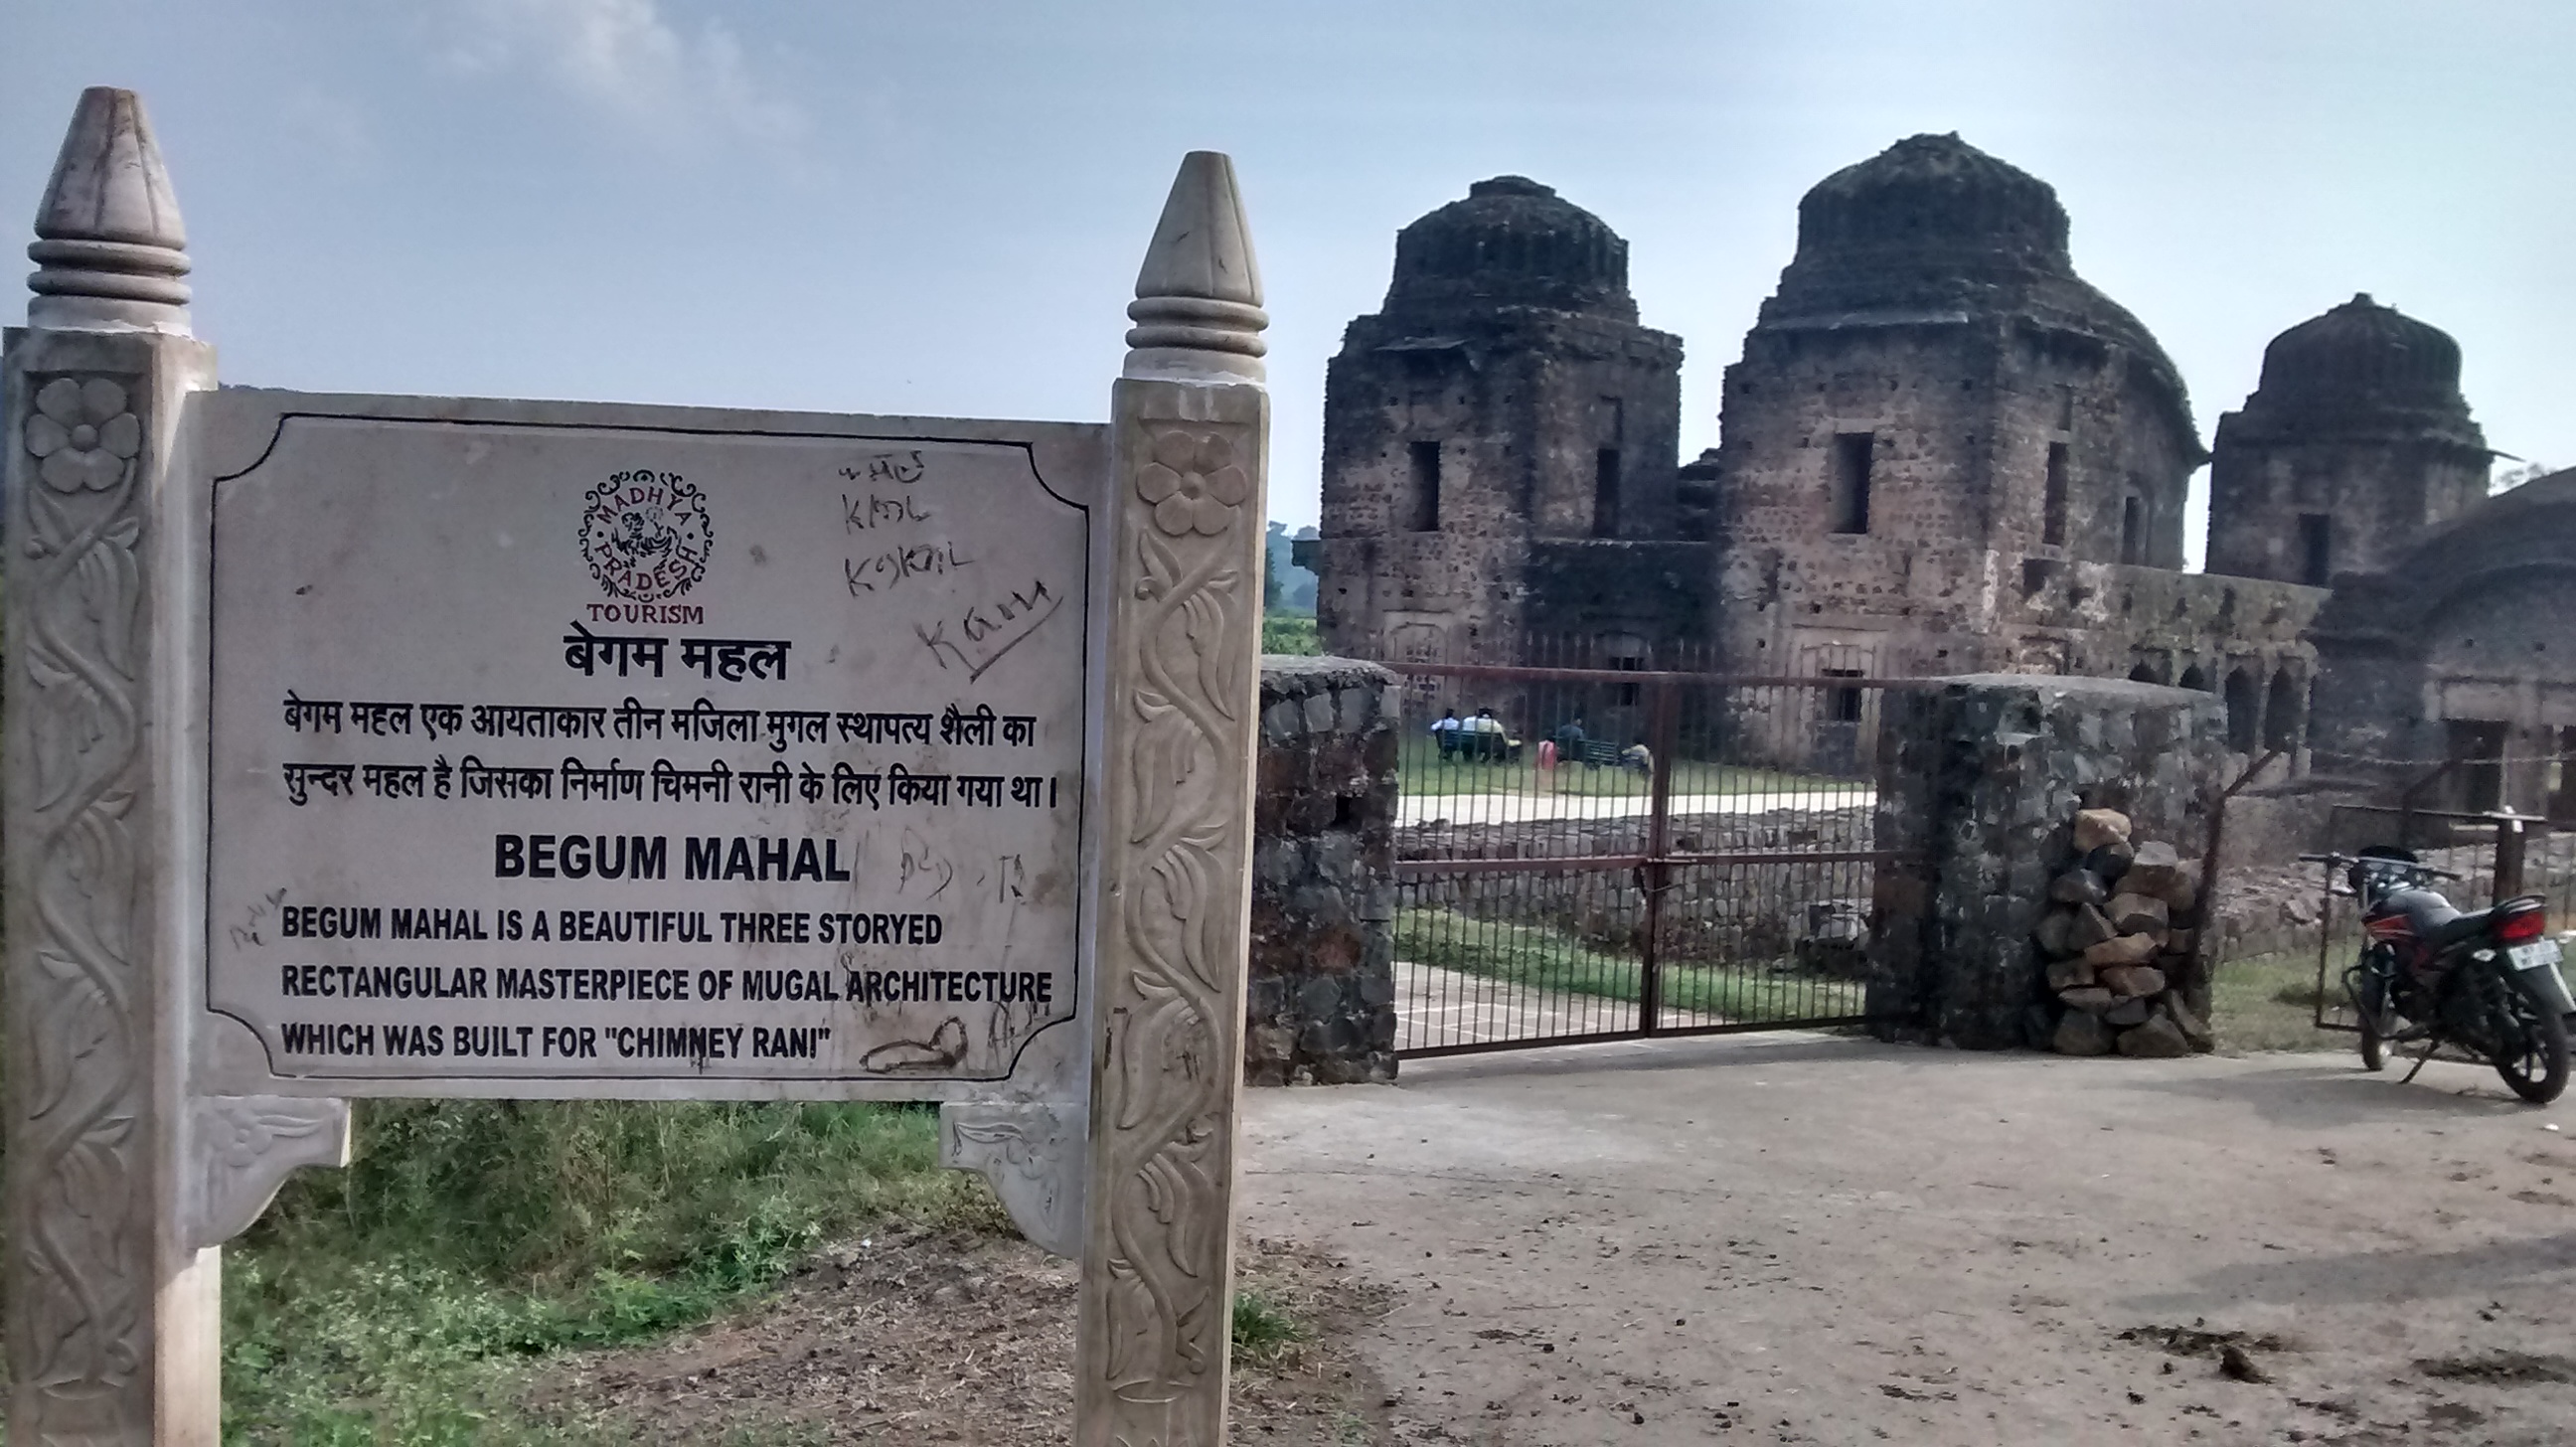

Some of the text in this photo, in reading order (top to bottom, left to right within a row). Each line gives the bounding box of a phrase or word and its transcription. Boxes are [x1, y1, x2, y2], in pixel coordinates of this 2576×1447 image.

[596, 486, 693, 525] MADHYA
[594, 541, 699, 591] PRADESH
[585, 603, 705, 625] TOURISM
[563, 619, 792, 683] बेगम महल
[283, 690, 1037, 752] बेगम महल एक आयताकार तीन मजिला मुगल स्थापत्य शैली का
[282, 762, 355, 807] सुन्दर
[362, 764, 427, 799] महल
[432, 754, 453, 800] है
[460, 754, 554, 800] जिसका
[560, 756, 645, 802] निर्माण
[651, 758, 733, 803] चिमनी
[738, 760, 793, 804] रानी
[798, 762, 826, 805] के
[831, 762, 882, 811] लिए
[887, 763, 952, 807] किया
[957, 775, 1005, 808] गया
[495, 834, 667, 881] BEGUM
[685, 836, 851, 883] MAHAL
[282, 905, 382, 939] BEGUM
[391, 908, 488, 941] MAHAL
[497, 909, 523, 941] IS
[531, 910, 551, 942] A
[559, 910, 713, 943] BEAUTIFUL
[721, 912, 810, 944] THREE
[817, 913, 942, 945] STORYED
[281, 965, 1052, 1003] RECTANGULAR MASTERPIECE OF MUGAL ARCHITECTURE
[281, 1022, 831, 1059] WHICH WAS BUILT FOR "CHIMNEY RANI"
